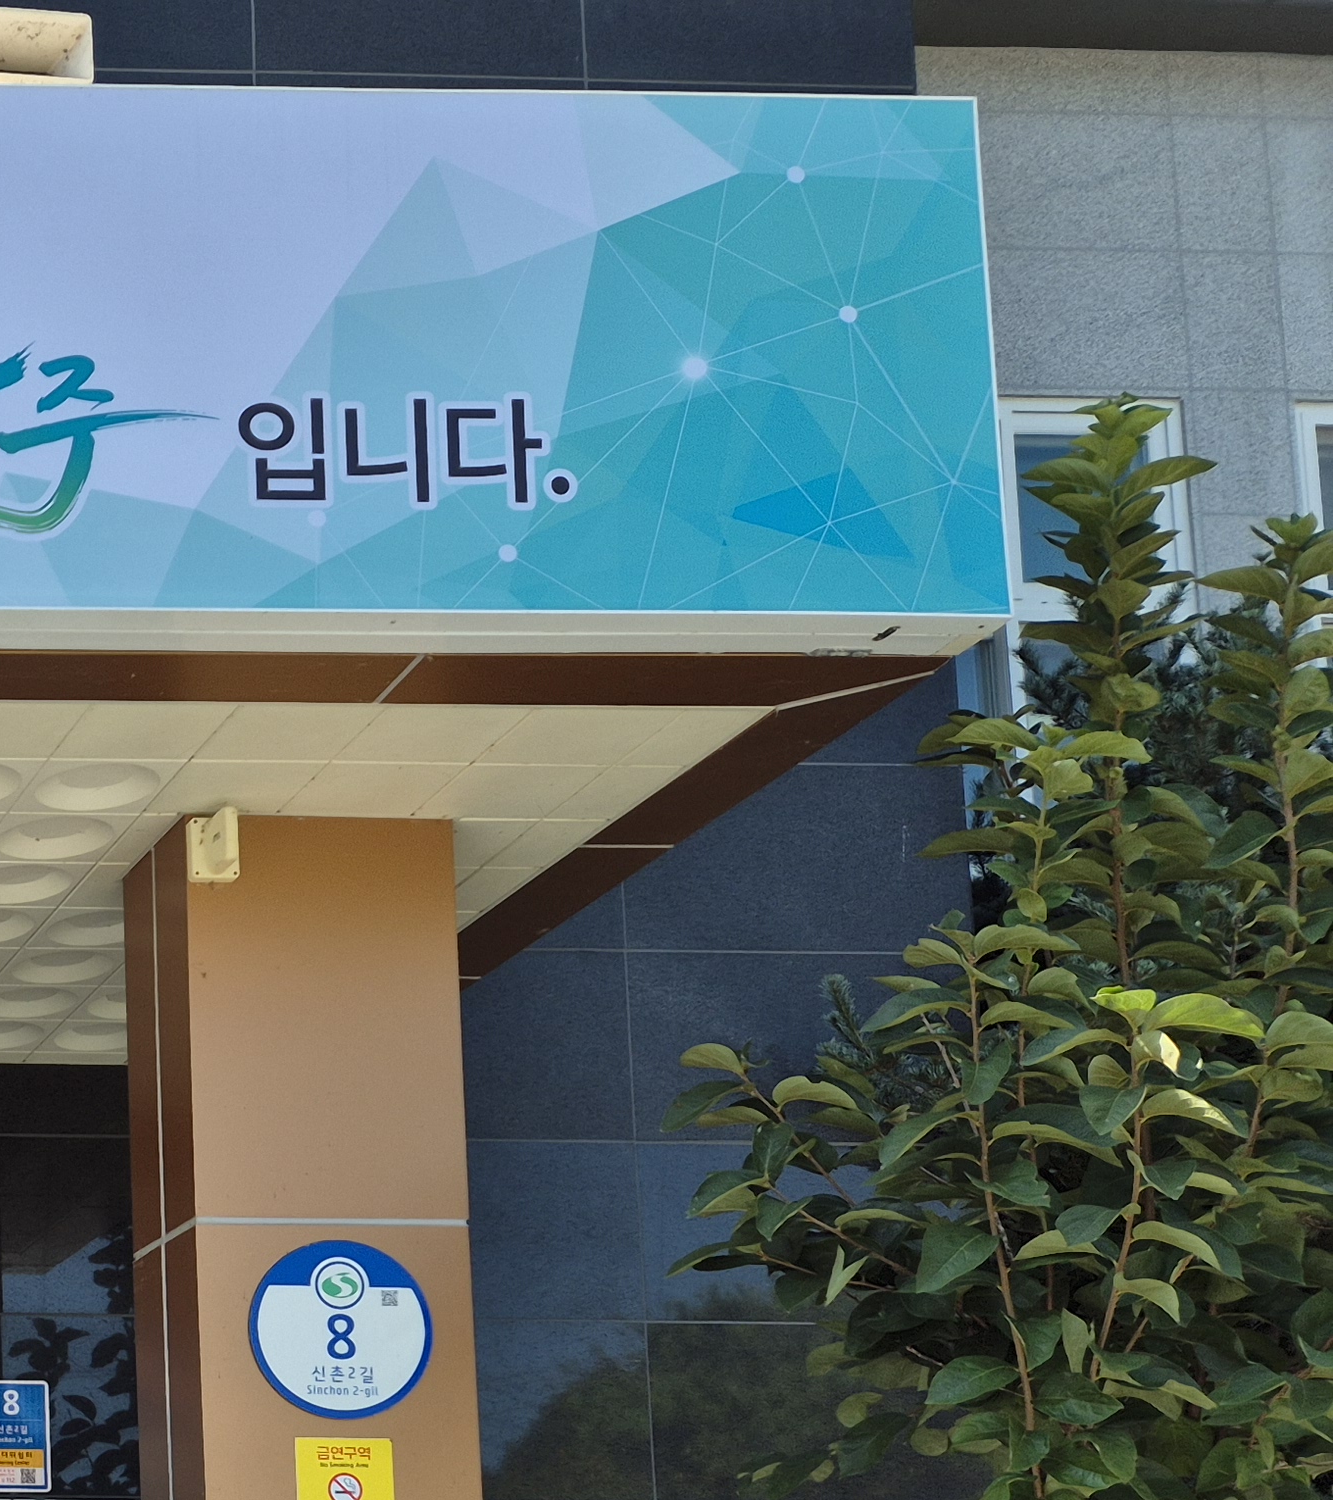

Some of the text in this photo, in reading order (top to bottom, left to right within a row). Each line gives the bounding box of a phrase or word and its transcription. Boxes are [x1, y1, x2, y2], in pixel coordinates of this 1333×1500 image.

[237, 396, 572, 504] 입니다.
[326, 1313, 357, 1360] 8
[312, 1366, 374, 1384] 신촌2길
[307, 1384, 379, 1398] Sinchon 2-gil
[3, 1389, 20, 1416] 8
[316, 1446, 371, 1460] 금연구역
